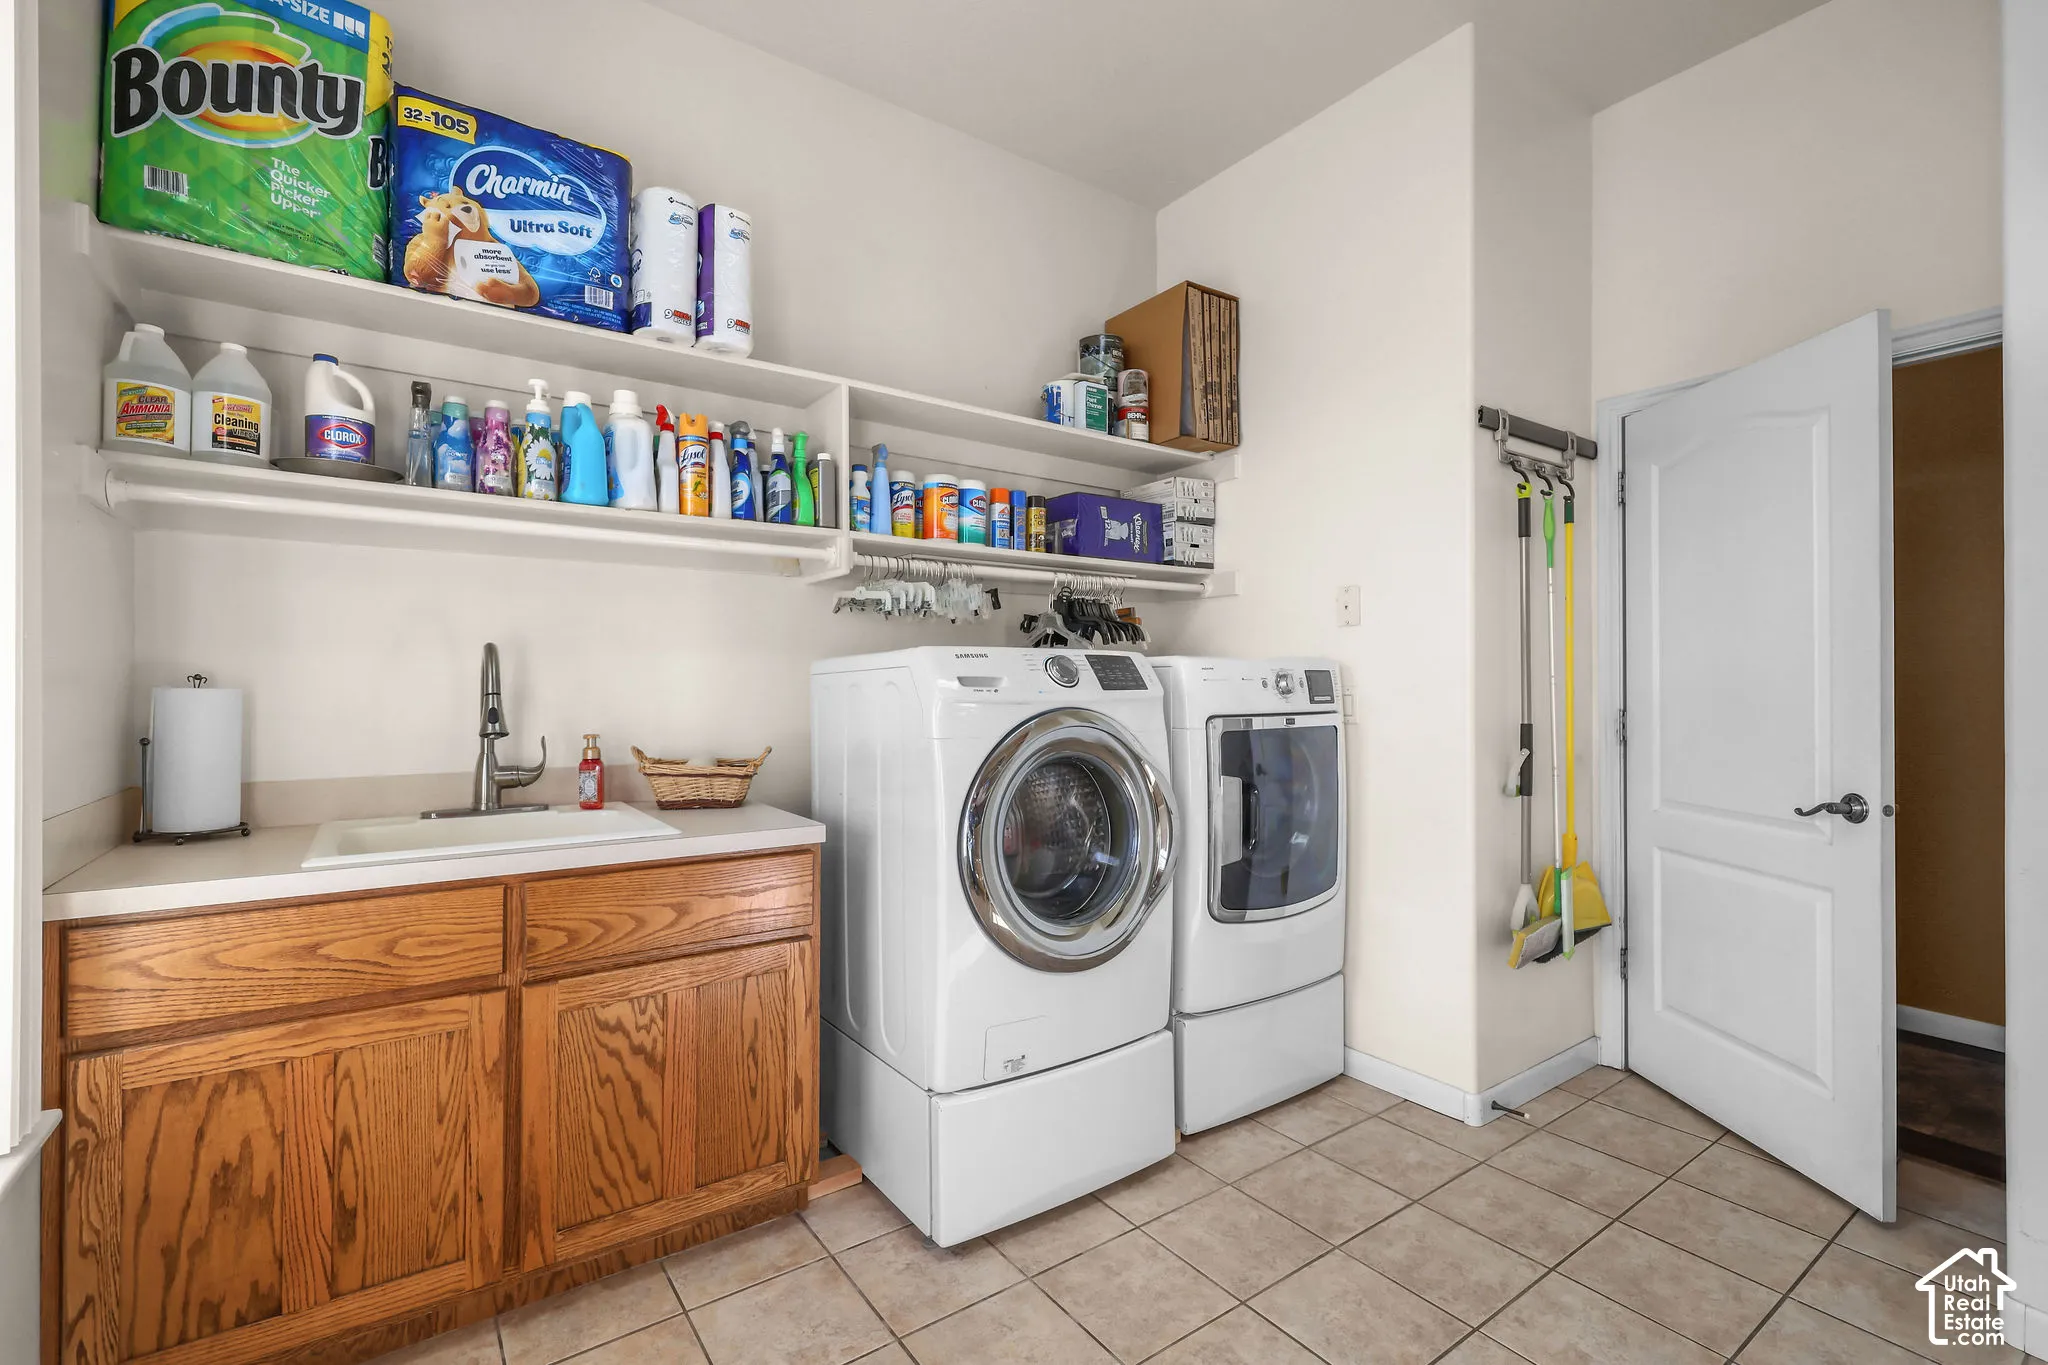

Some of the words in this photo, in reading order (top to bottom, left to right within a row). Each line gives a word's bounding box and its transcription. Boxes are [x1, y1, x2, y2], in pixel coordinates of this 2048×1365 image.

[113, 47, 362, 136] Bounty
[271, 157, 300, 177] The
[270, 169, 331, 198] Quicker
[465, 163, 573, 206] Charmin
[271, 182, 319, 206] Picker
[270, 192, 318, 218] Upper
[509, 218, 555, 233] Ultra
[557, 220, 593, 239] Soft
[474, 253, 513, 262] absorbent
[664, 308, 673, 320] 9
[726, 318, 735, 329] 9
[120, 401, 171, 415] AMMONIA
[214, 413, 259, 434] Cleaning
[324, 430, 361, 444] CLOROX
[681, 448, 705, 465] Lysol
[892, 492, 914, 506] Lysol
